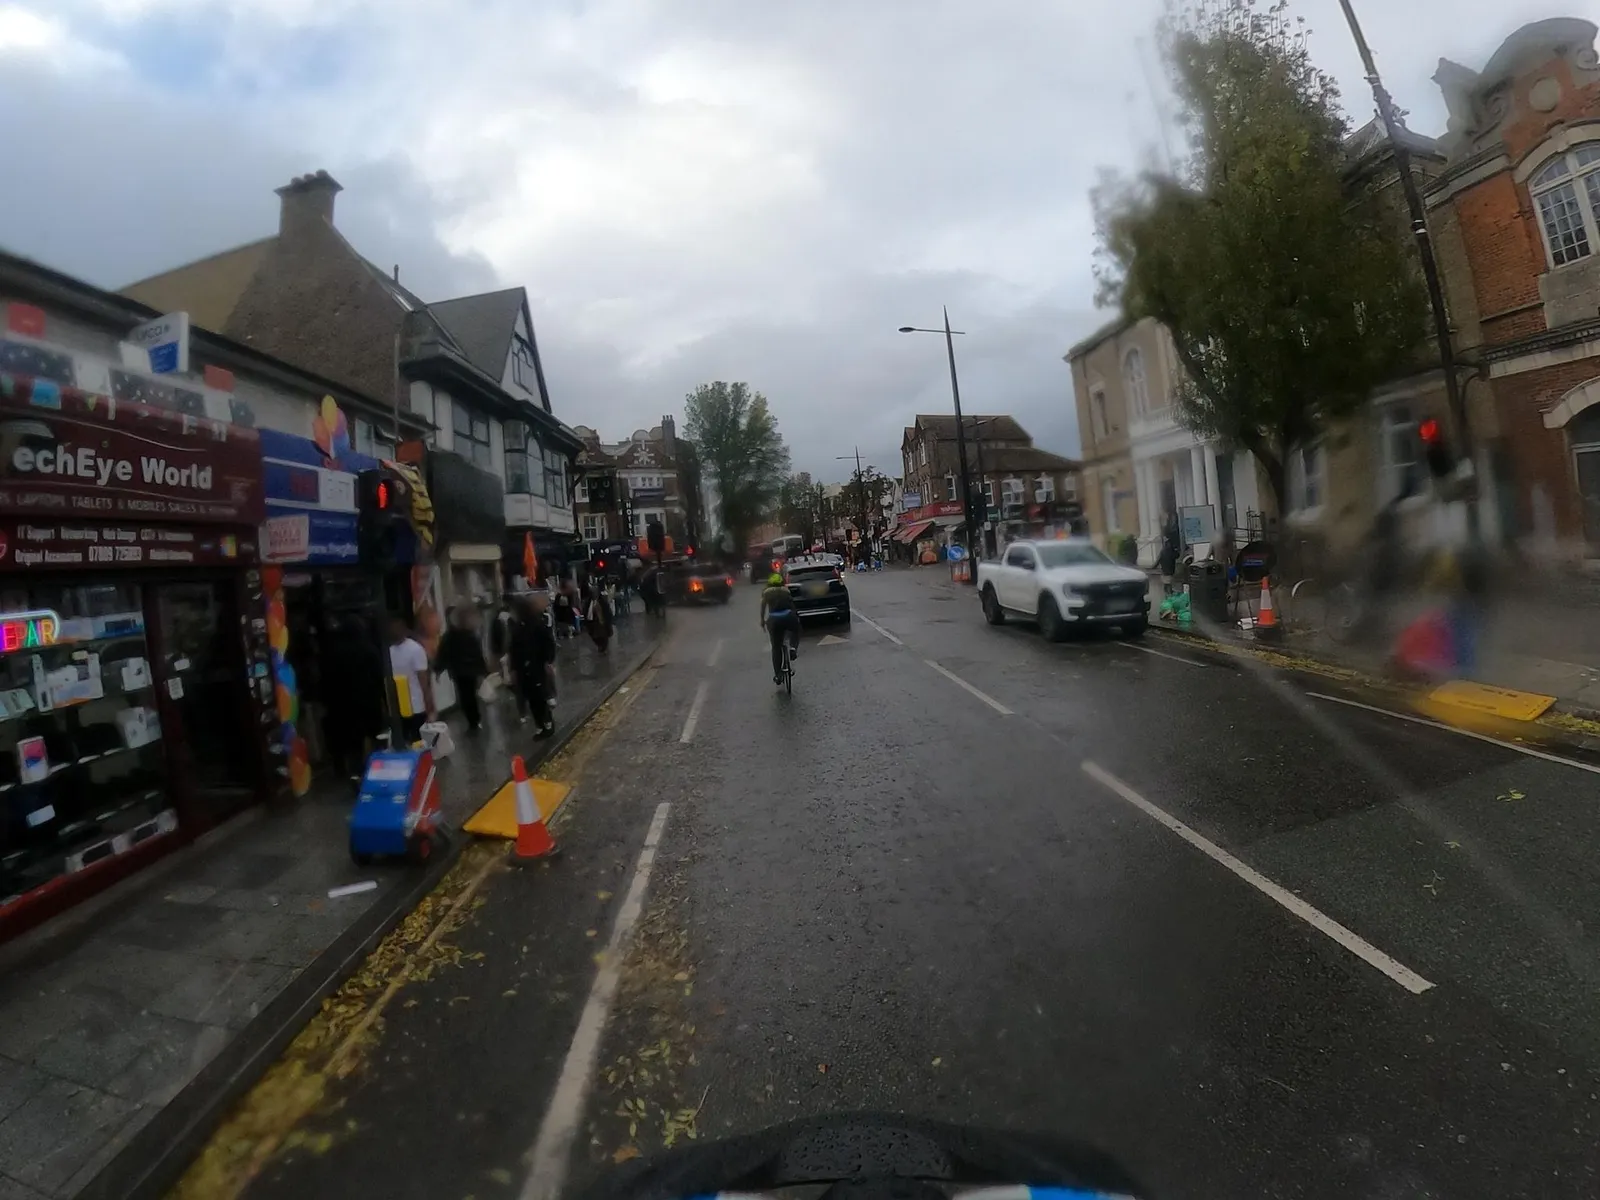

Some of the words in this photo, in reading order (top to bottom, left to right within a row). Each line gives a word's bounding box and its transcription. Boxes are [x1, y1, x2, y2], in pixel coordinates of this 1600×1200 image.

[140, 455, 212, 490] World
[71, 495, 112, 509] TABLETS
[127, 499, 165, 512] MOBILES
